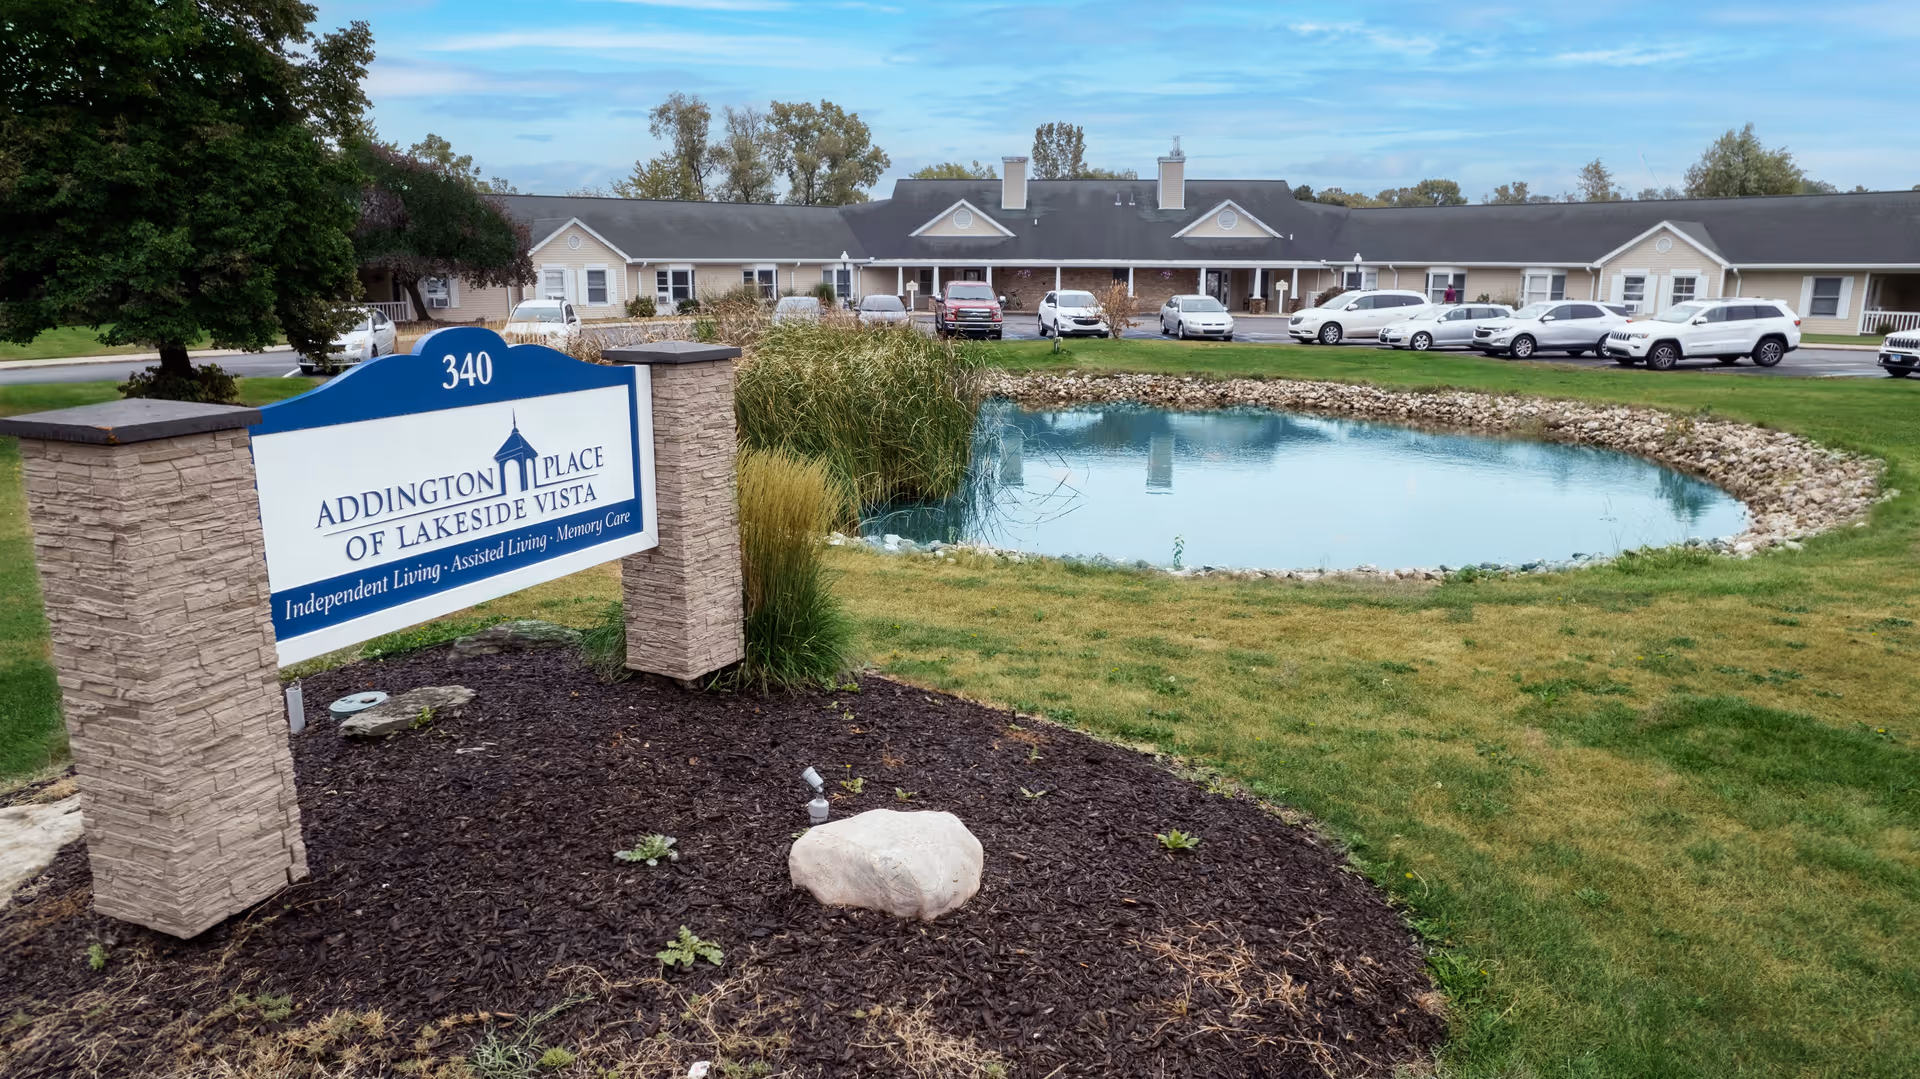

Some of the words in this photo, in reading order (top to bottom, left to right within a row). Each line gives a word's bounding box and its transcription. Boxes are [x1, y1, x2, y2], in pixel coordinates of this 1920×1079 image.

[442, 350, 493, 390] 340
[315, 467, 495, 529] ADDINGTON
[543, 445, 604, 479] PLACE
[345, 530, 386, 561] OF
[396, 498, 528, 550] LAKESIDE
[533, 481, 598, 514] VISTA
[285, 576, 389, 620] Independent
[393, 563, 441, 590] Living
[451, 545, 504, 573] Assisted
[507, 534, 548, 558] Living
[556, 519, 604, 543] Memory
[606, 510, 631, 529] Care
